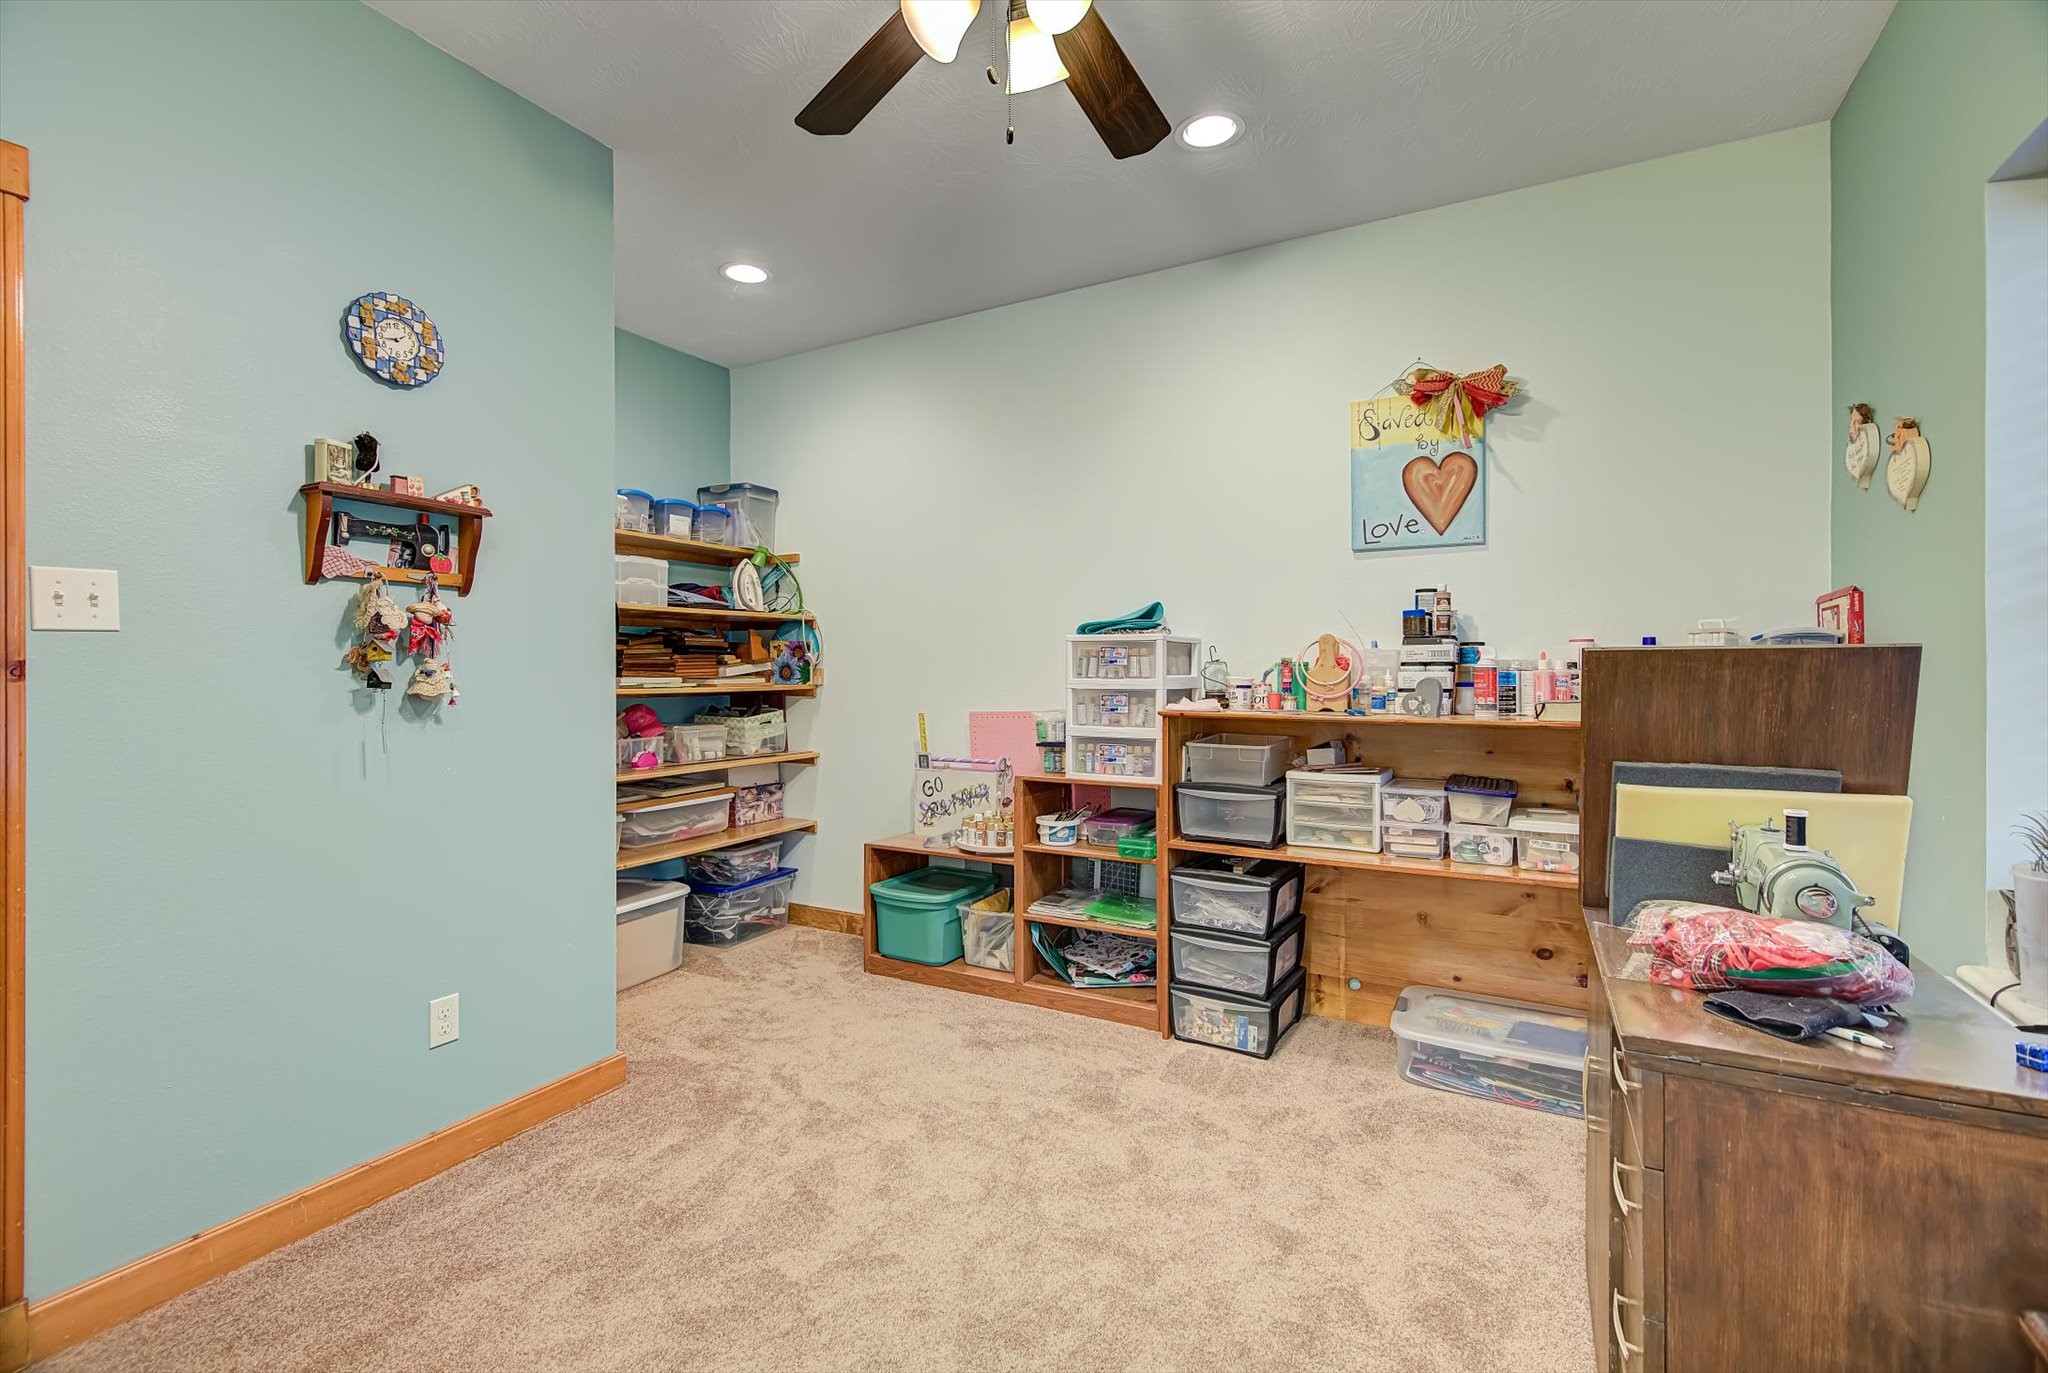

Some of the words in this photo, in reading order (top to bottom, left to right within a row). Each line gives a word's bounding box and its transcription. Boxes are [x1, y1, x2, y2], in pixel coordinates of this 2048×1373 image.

[392, 322, 400, 330] 12
[411, 340, 415, 348] 3
[388, 347, 393, 355] 7
[396, 350, 401, 358] 6
[403, 350, 408, 359] 5
[408, 348, 413, 356] 4
[1358, 401, 1434, 442] Saved
[1415, 433, 1439, 456] by
